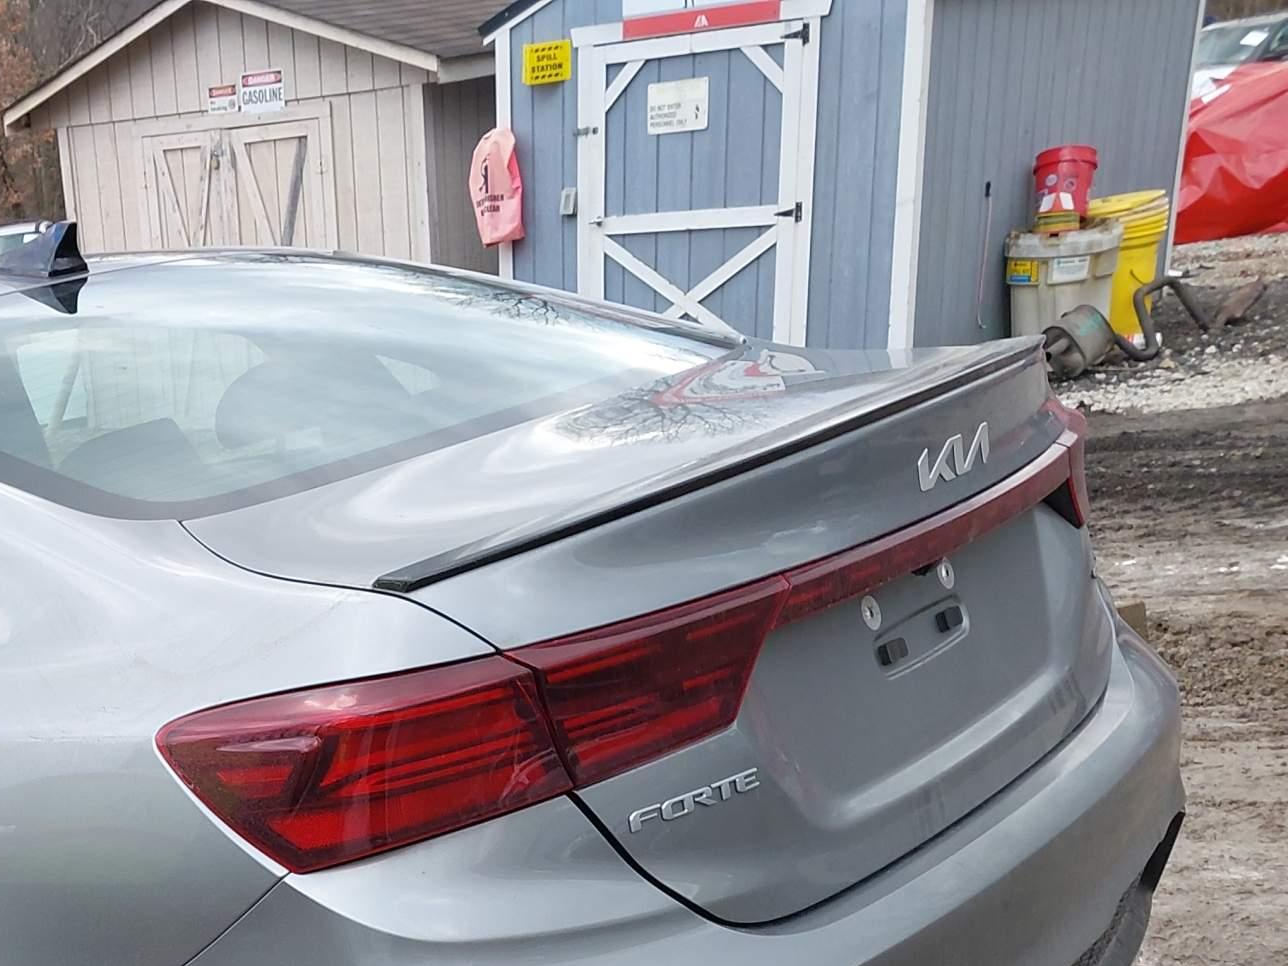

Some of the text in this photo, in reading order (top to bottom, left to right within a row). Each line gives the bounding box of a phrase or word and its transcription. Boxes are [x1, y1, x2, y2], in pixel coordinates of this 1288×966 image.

[536, 52, 557, 62] SPILL
[531, 62, 563, 73] STATION
[242, 87, 283, 105] GASOLINE
[917, 421, 990, 492] KIA
[629, 767, 760, 833] FORTE
